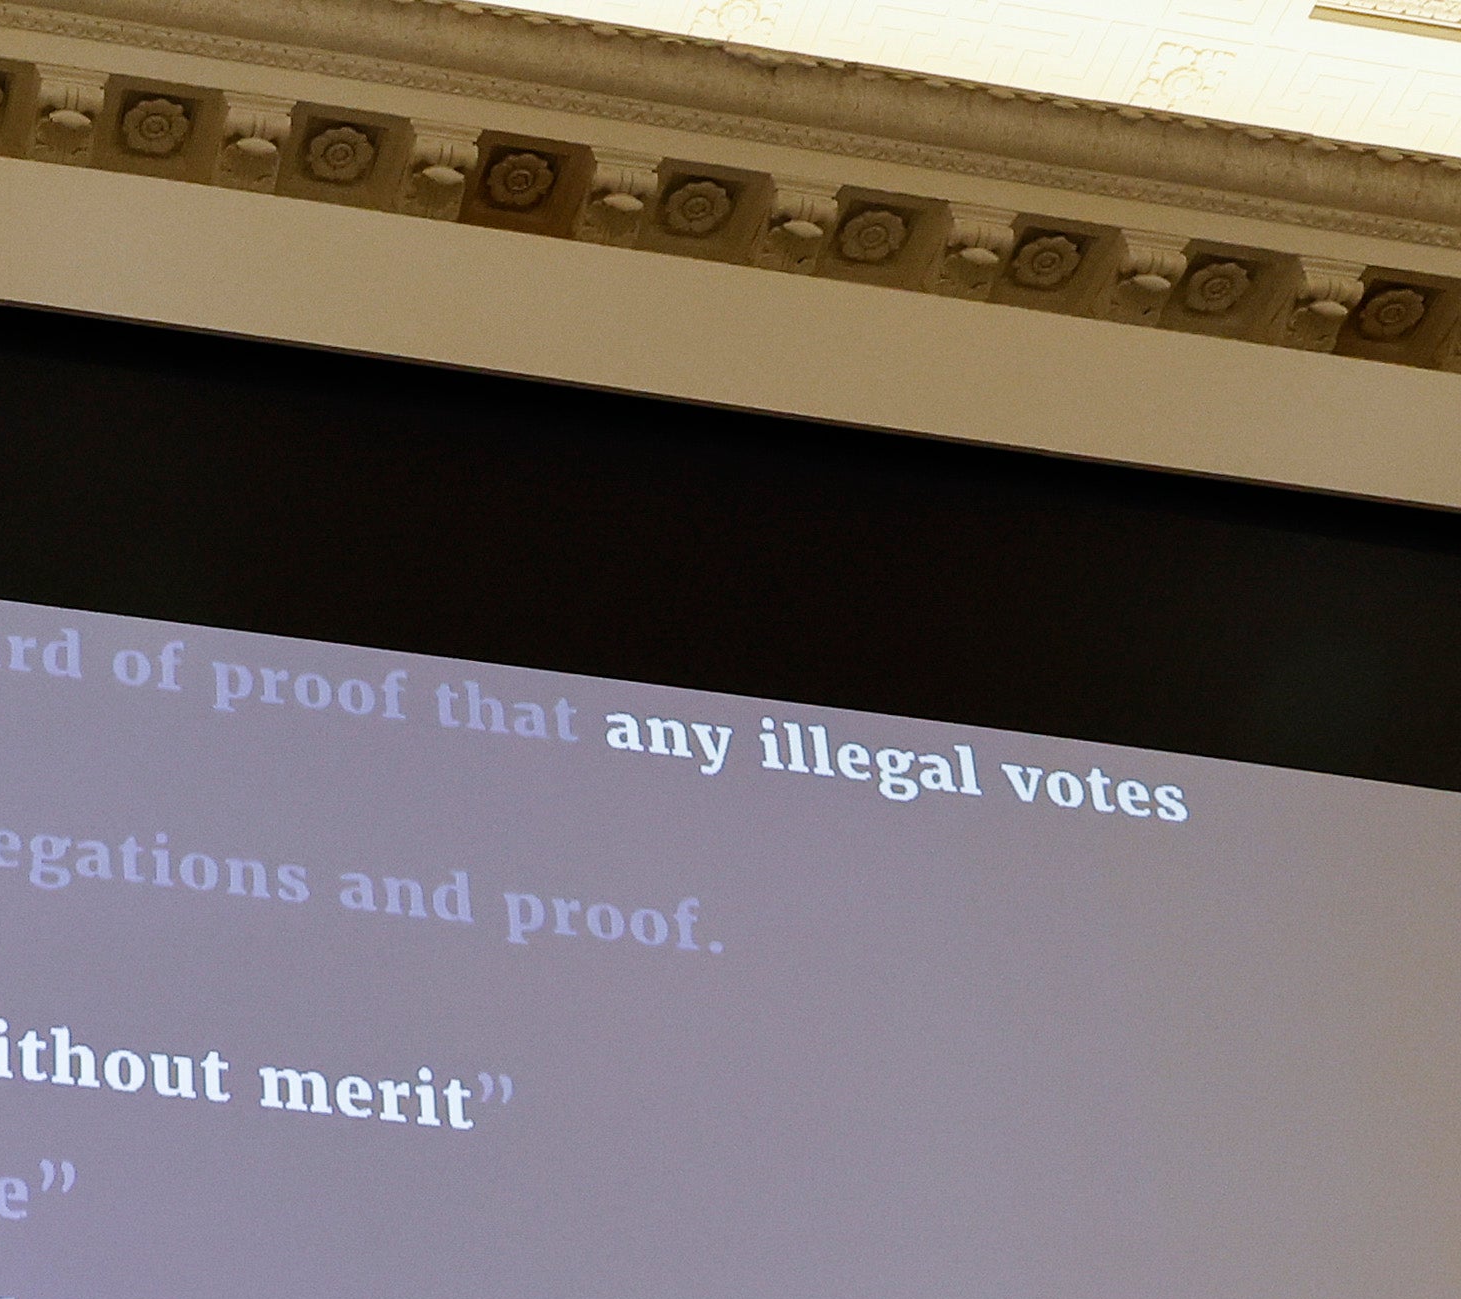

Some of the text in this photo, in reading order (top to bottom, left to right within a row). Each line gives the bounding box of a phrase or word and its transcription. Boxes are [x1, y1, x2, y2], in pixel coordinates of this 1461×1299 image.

[112, 639, 185, 692] of
[211, 660, 407, 720] proof
[435, 680, 578, 742] that
[604, 712, 734, 777] any
[758, 716, 984, 803] illegal
[999, 762, 1191, 824] votes
[338, 869, 474, 924] and
[502, 891, 724, 954] proof.
[257, 1064, 514, 1132] merit”
